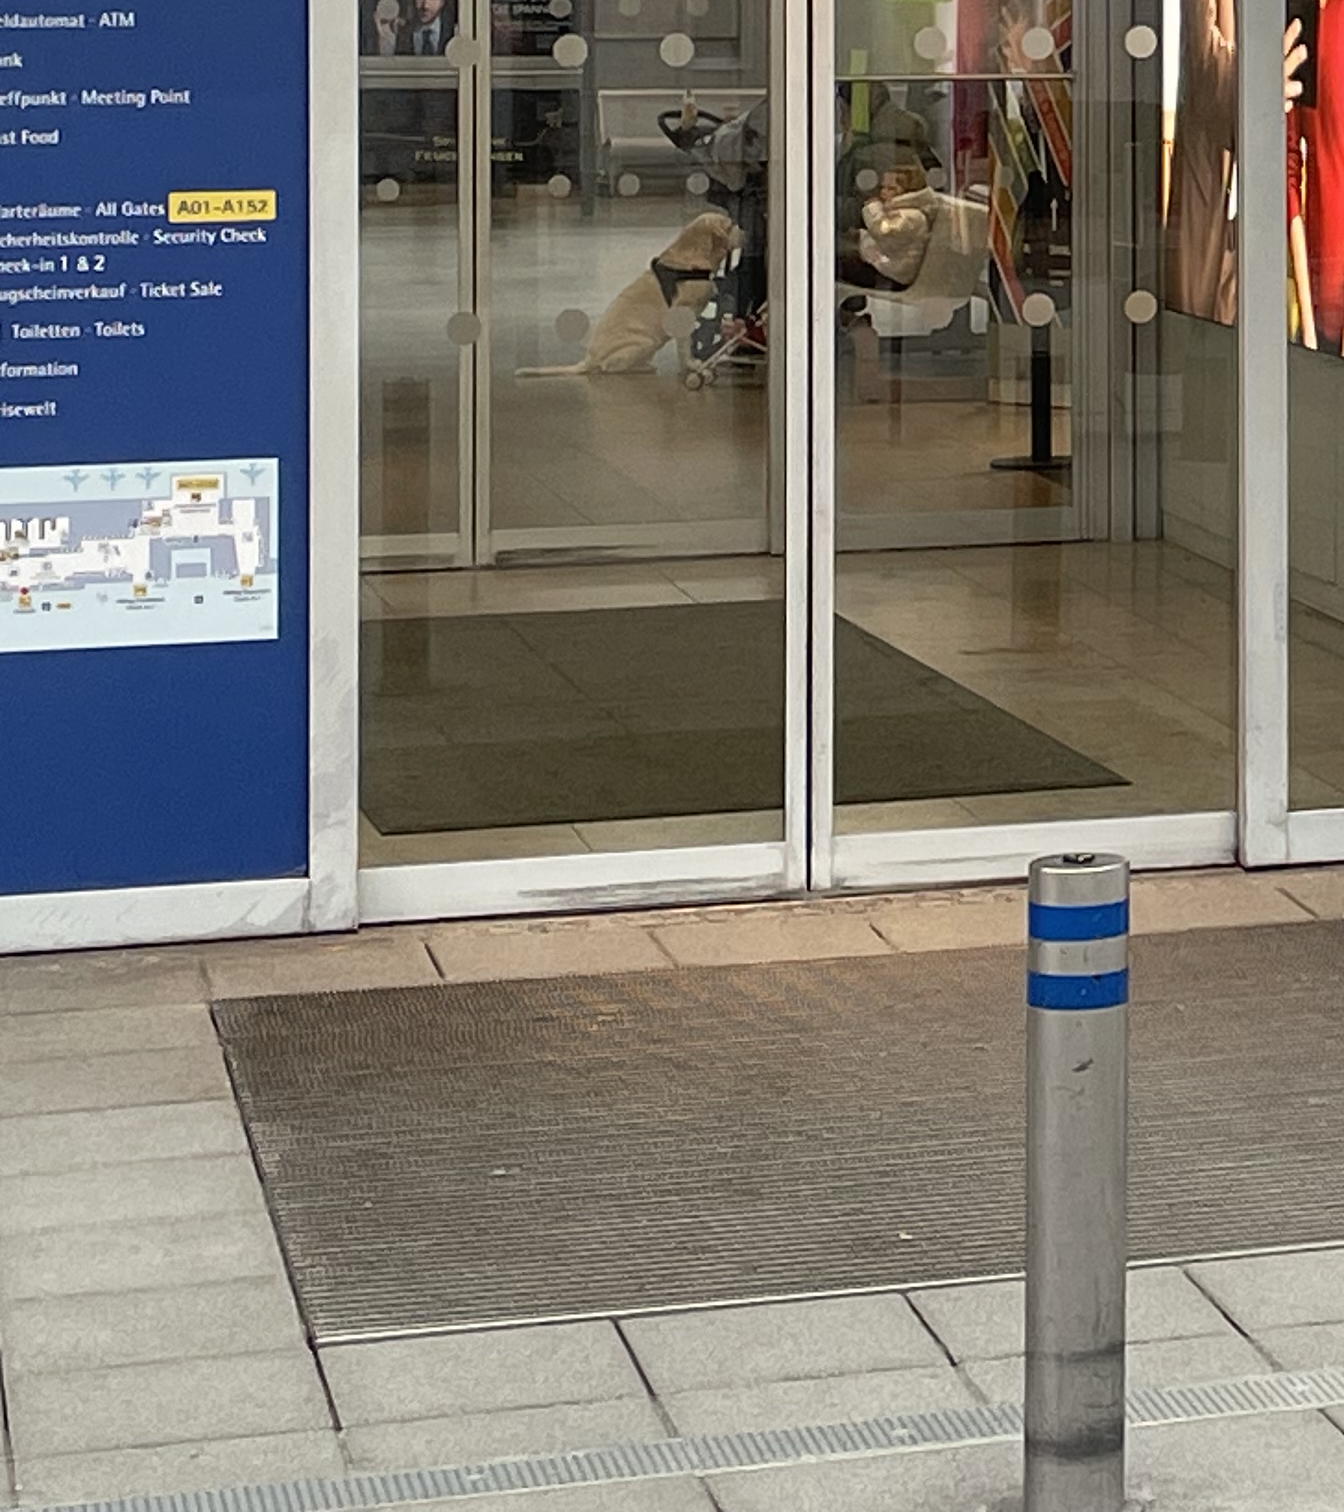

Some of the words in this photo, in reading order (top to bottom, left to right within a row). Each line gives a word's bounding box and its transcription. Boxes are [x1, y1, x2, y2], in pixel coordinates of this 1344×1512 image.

[99, 12, 136, 27] ATM
[80, 90, 147, 108] Meeting
[150, 89, 191, 105] Point
[0, 130, 17, 146] st
[21, 129, 61, 145] Food
[0, 202, 83, 219] arteräume
[95, 201, 118, 217] All
[121, 200, 166, 216] Gates
[176, 199, 269, 216] A01-A152
[152, 228, 217, 247] Security
[220, 227, 267, 244] Check
[60, 256, 68, 272] 1
[77, 256, 90, 272] &
[93, 255, 106, 271] 2
[139, 282, 186, 299] Ticket
[189, 281, 223, 297] Sale
[11, 323, 82, 340] Toiletten
[93, 321, 146, 338] Toilets
[0, 400, 57, 418] isewelt
